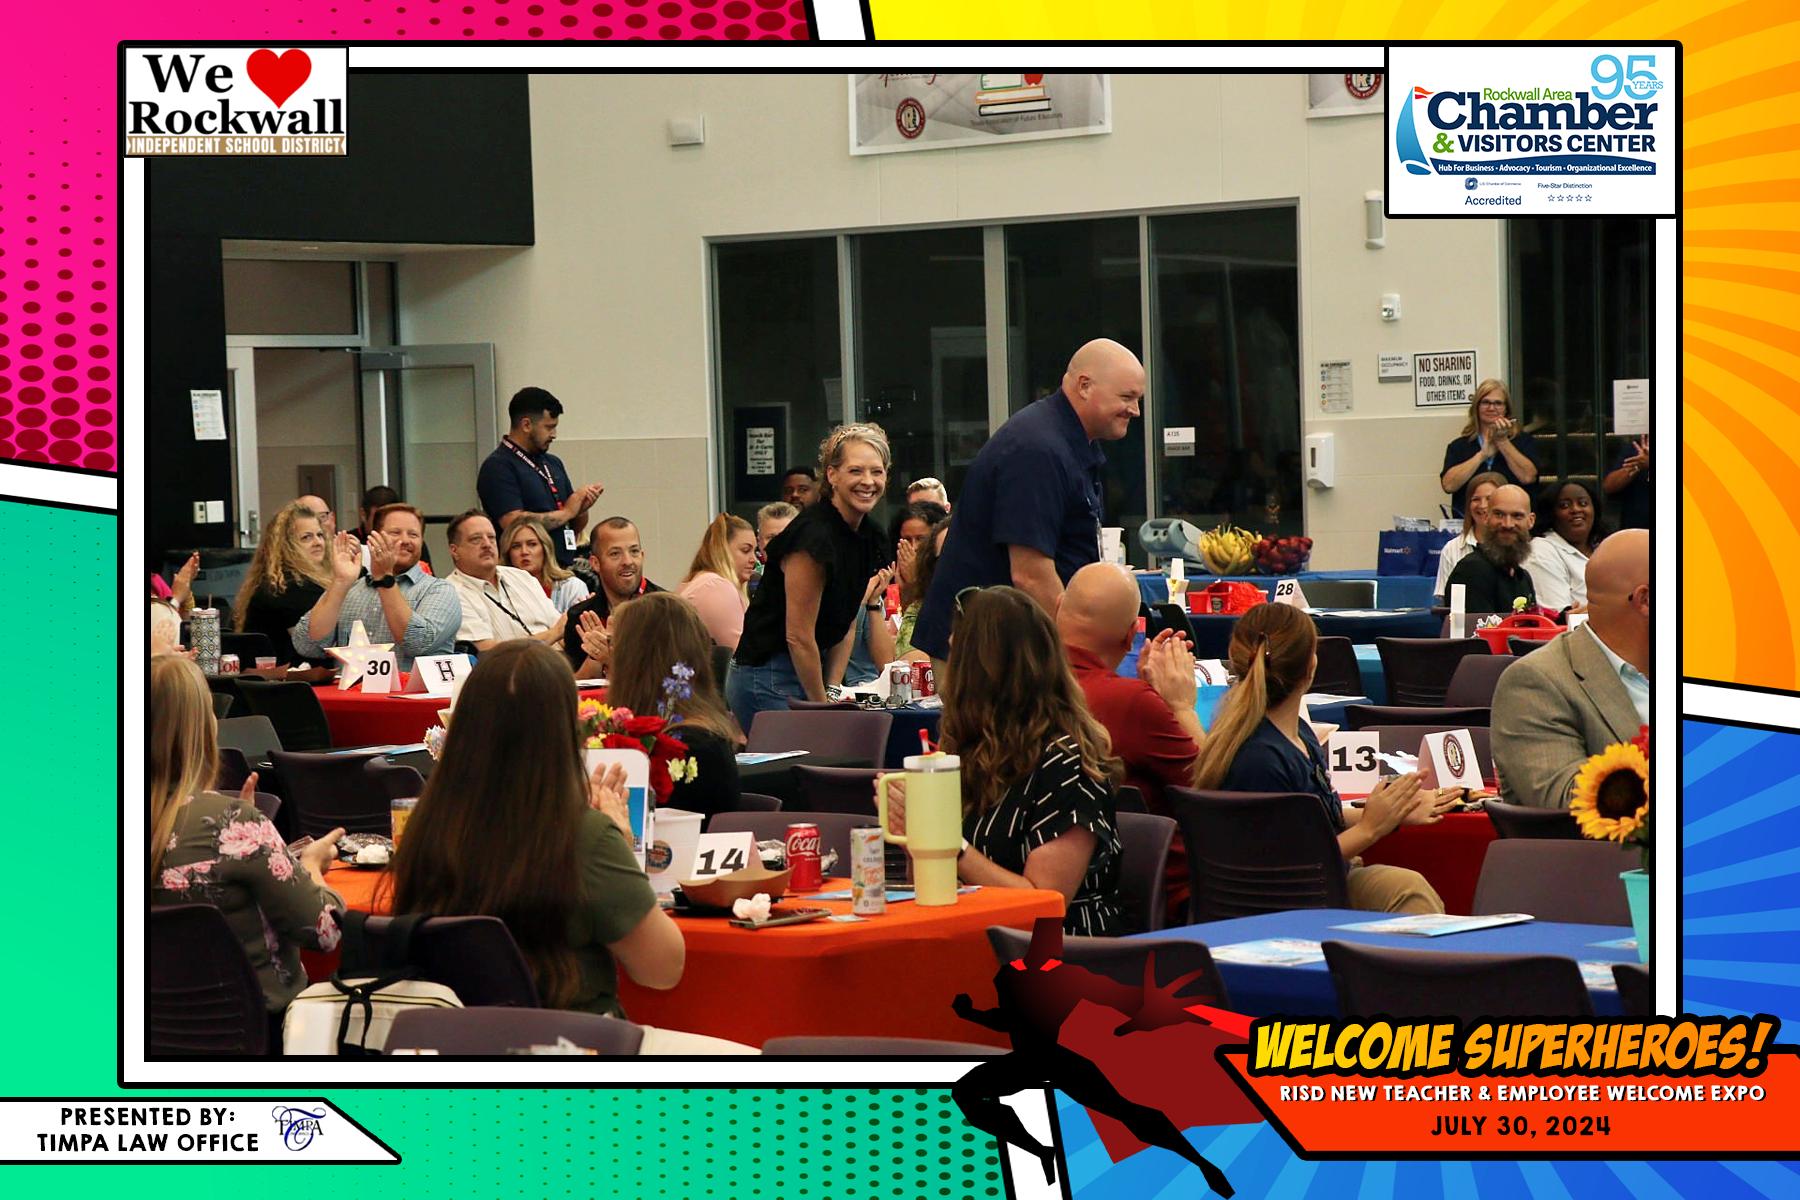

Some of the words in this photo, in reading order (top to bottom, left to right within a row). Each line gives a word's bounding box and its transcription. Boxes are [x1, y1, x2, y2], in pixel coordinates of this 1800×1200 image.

[1419, 358, 1431, 372] NO
[1433, 356, 1472, 371] SHARING
[1464, 374, 1472, 385] OR
[1426, 390, 1447, 402] OTHER
[1447, 389, 1466, 401] ITEMS
[1277, 583, 1294, 596] 28
[367, 660, 391, 676] 30
[1332, 745, 1377, 772] 13
[696, 848, 745, 875] 14
